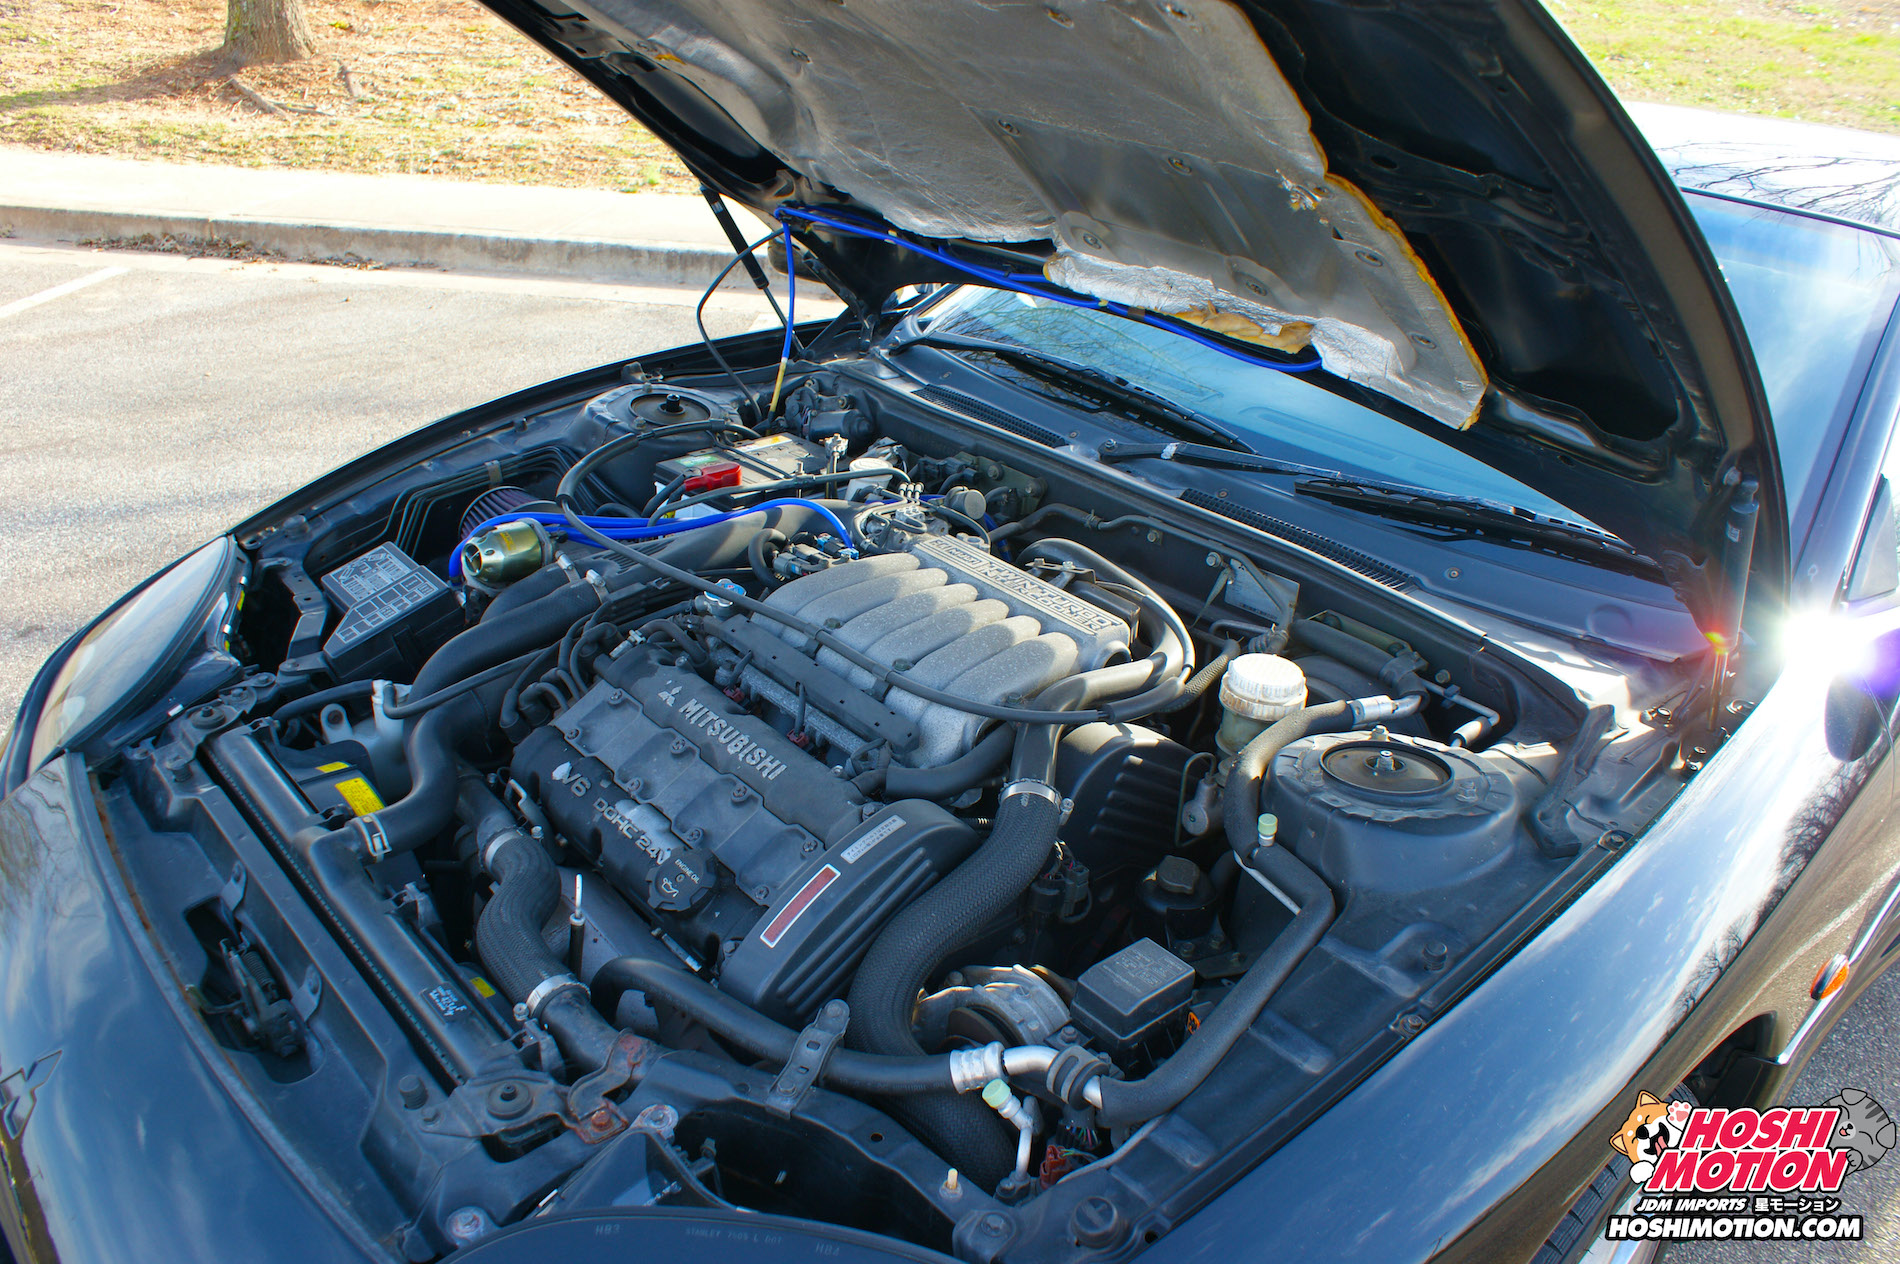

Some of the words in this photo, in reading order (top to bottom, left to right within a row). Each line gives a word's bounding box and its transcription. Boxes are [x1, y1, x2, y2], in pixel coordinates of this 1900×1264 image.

[977, 567, 1102, 630] INTERCOOLER
[985, 563, 1038, 590] TWIN
[1039, 588, 1112, 627] TURBO
[678, 698, 787, 781] MITSUBISHI
[561, 766, 592, 797] V6
[593, 797, 639, 840] DOHC
[635, 834, 672, 865] 24V
[675, 859, 694, 878] ENGINE
[690, 873, 701, 884] OIL
[595, 1224, 621, 1236] HB3
